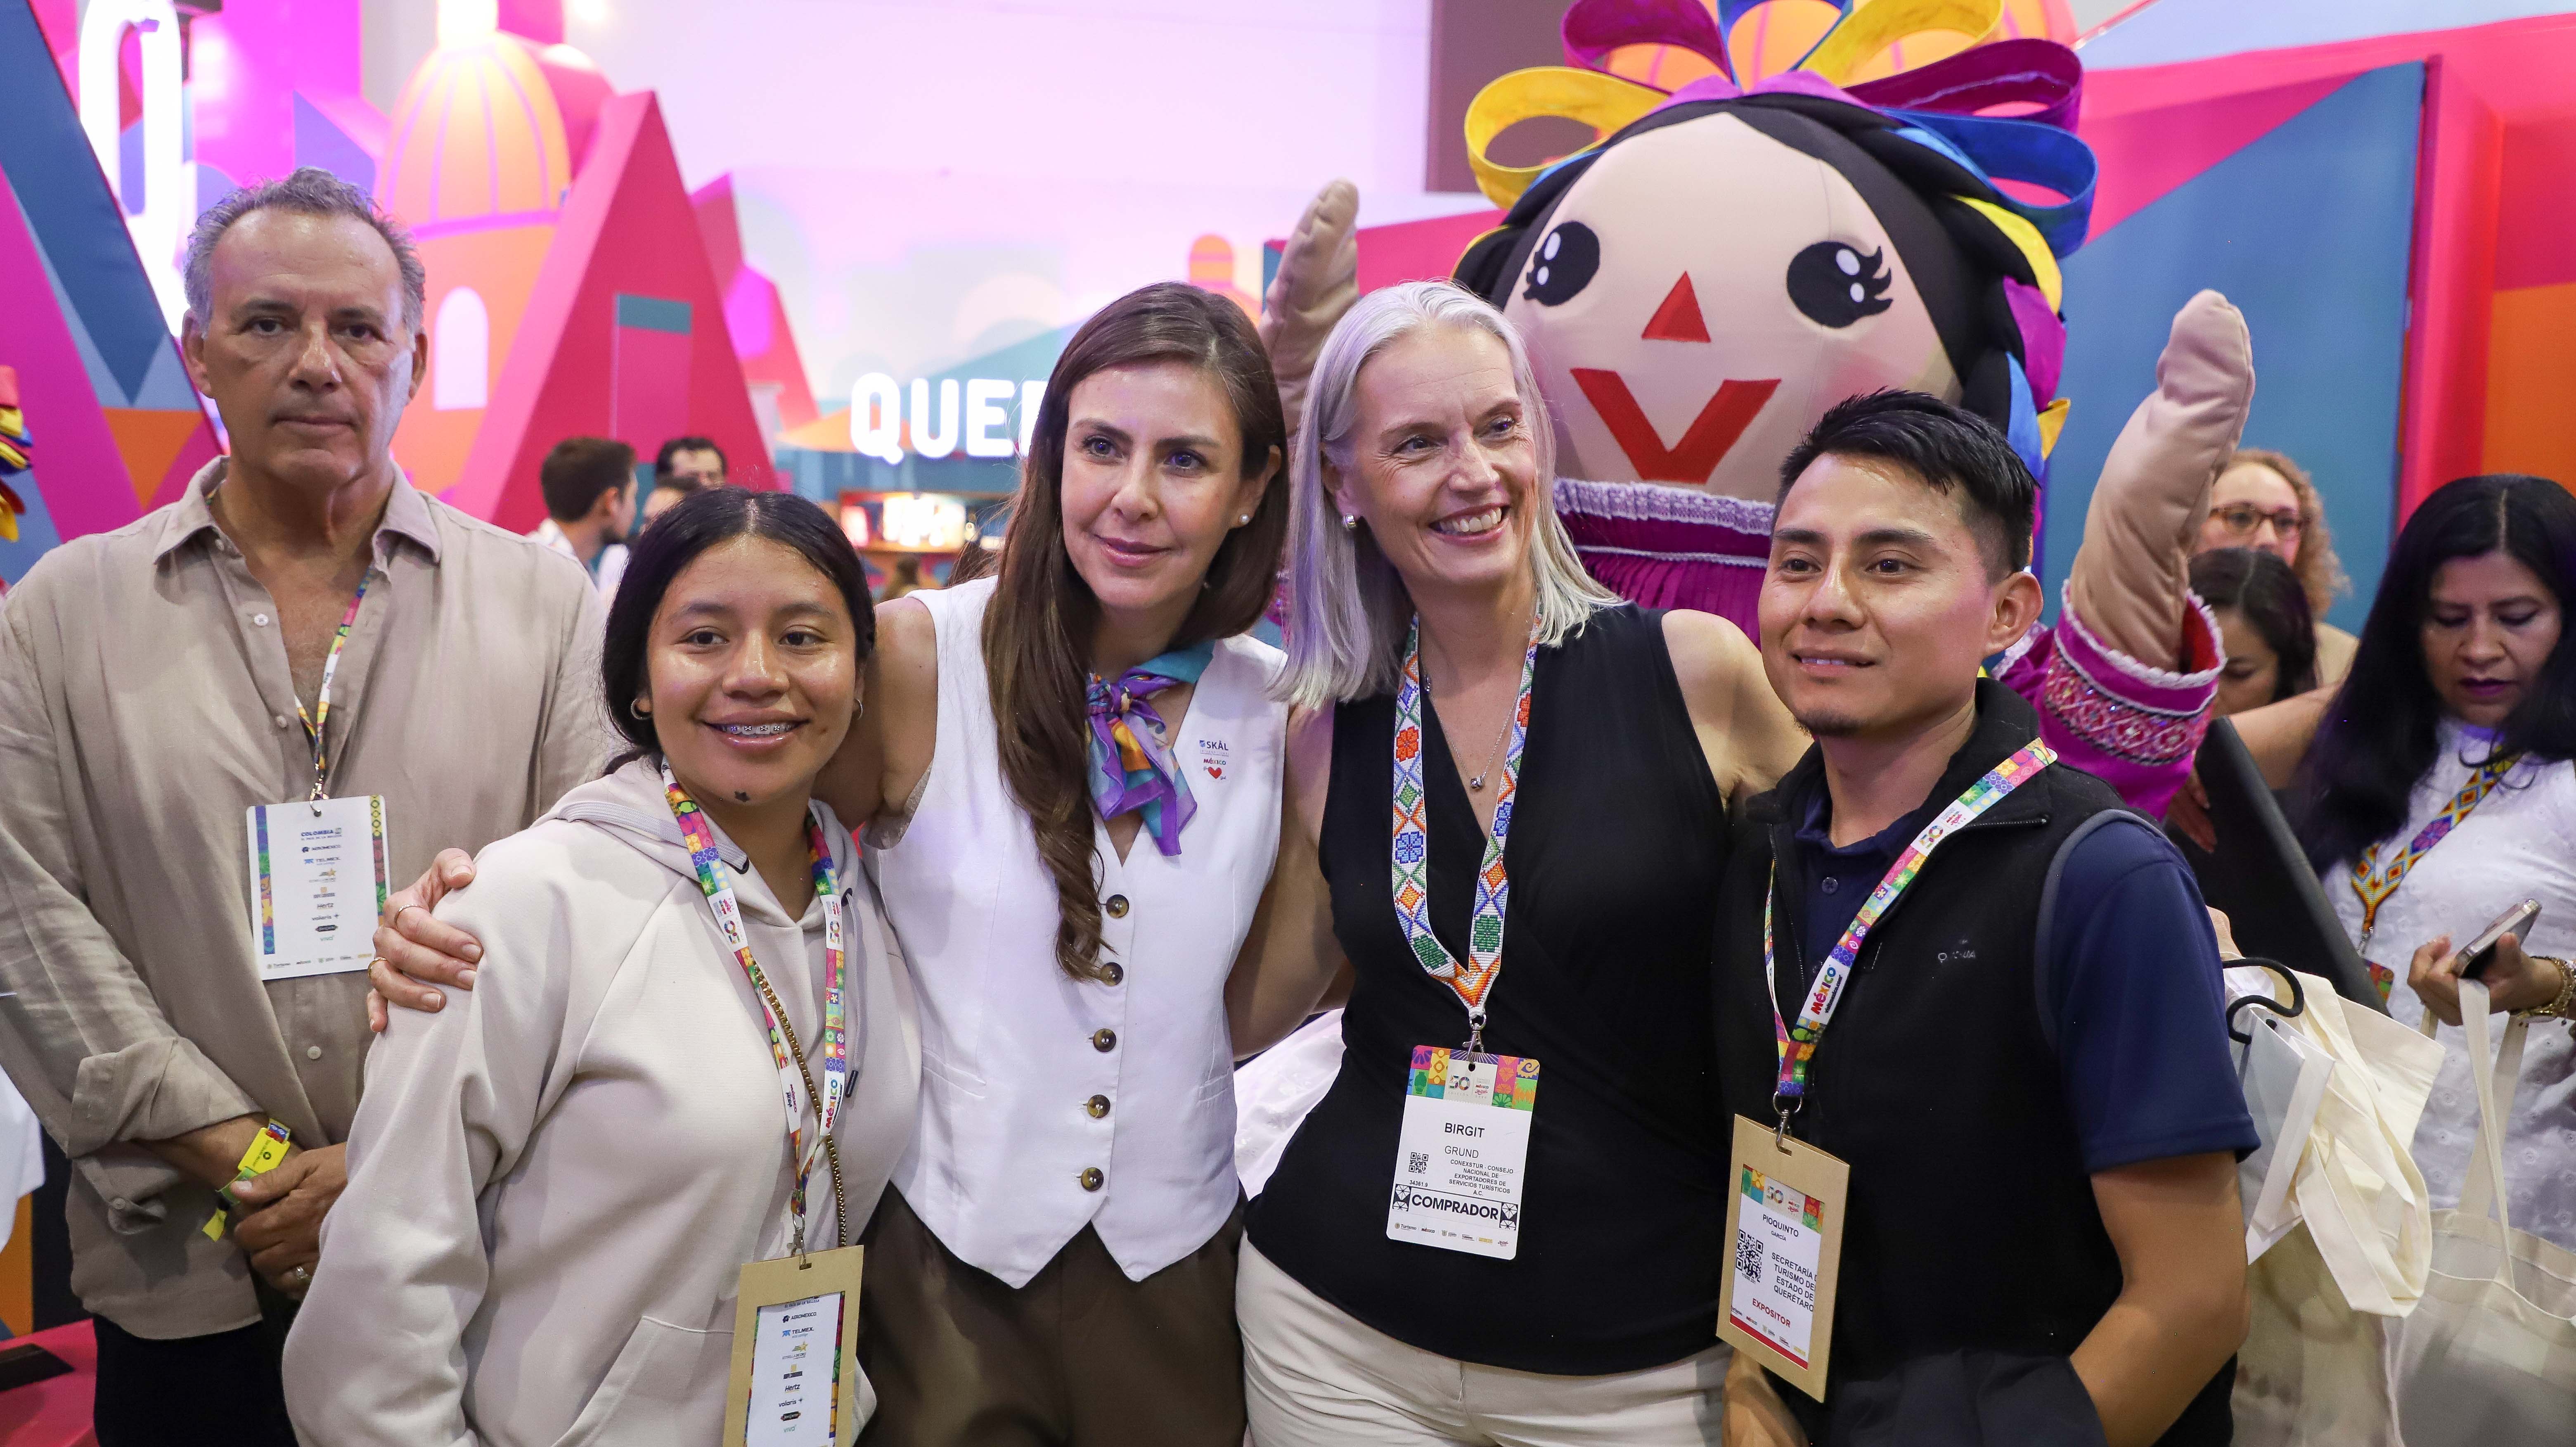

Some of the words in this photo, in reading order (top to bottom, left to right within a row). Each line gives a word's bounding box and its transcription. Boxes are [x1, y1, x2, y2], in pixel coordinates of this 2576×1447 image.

[1444, 1122, 1485, 1138] BIRGIT
[1444, 1146, 1479, 1158] GRUND
[1450, 1159, 1483, 1169] CONEXSTUR
[1487, 1165, 1513, 1174] CONSEJO
[1463, 1168, 1490, 1177] NACIONAL
[1449, 1179, 1477, 1188] SERVICIOS
[1479, 1184, 1510, 1193] TURÍSTICOS
[1454, 1173, 1497, 1185] EXPORTADORES
[1412, 1194, 1499, 1220] COMPRADOR
[1763, 1214, 1799, 1237] PIOQUINTO
[1771, 1231, 1786, 1241] GARCÍA
[1771, 1252, 1813, 1279] SECRETARÍA
[1774, 1264, 1804, 1285] TURISMO
[1776, 1275, 1803, 1295] ESTADO
[1774, 1285, 1814, 1312] QUERÉTARO
[1752, 1298, 1791, 1328] EXPOSITOR
[779, 1399, 796, 1407] volaris
